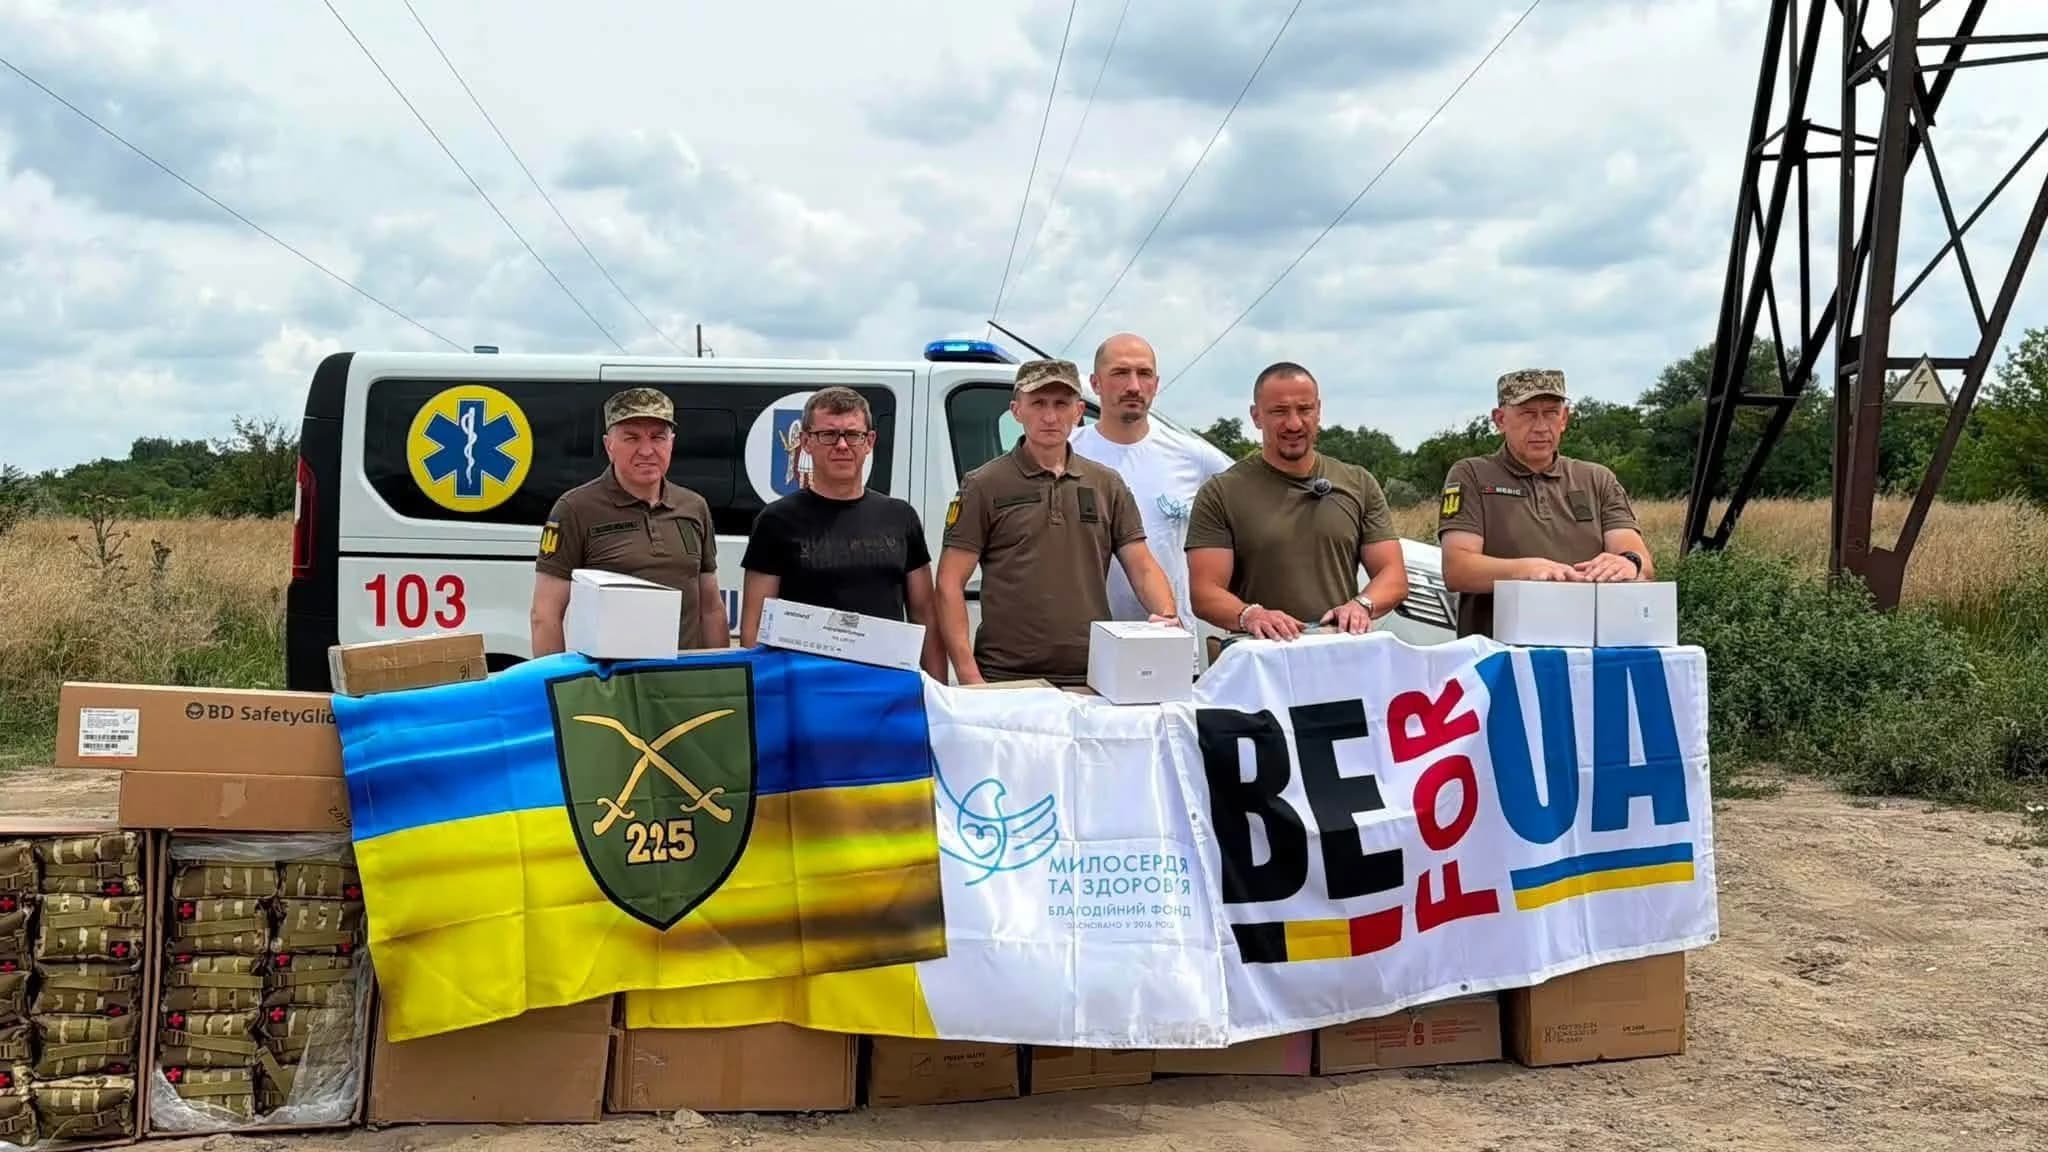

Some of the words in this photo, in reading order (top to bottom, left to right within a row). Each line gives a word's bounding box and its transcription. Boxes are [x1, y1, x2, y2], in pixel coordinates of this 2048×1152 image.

[365, 573, 466, 629] 103
[207, 704, 234, 720] BD
[1474, 647, 1690, 845] UA
[1196, 698, 1404, 904] BE
[1386, 678, 1500, 933] FOR
[625, 818, 696, 865] 225
[1048, 854, 1189, 876] МИЛОСЕРДЯ
[1048, 878, 1073, 895] ТА
[1048, 902, 1146, 918] БЛАГОДІЙНИЙ
[1151, 904, 1192, 918] ФОНД
